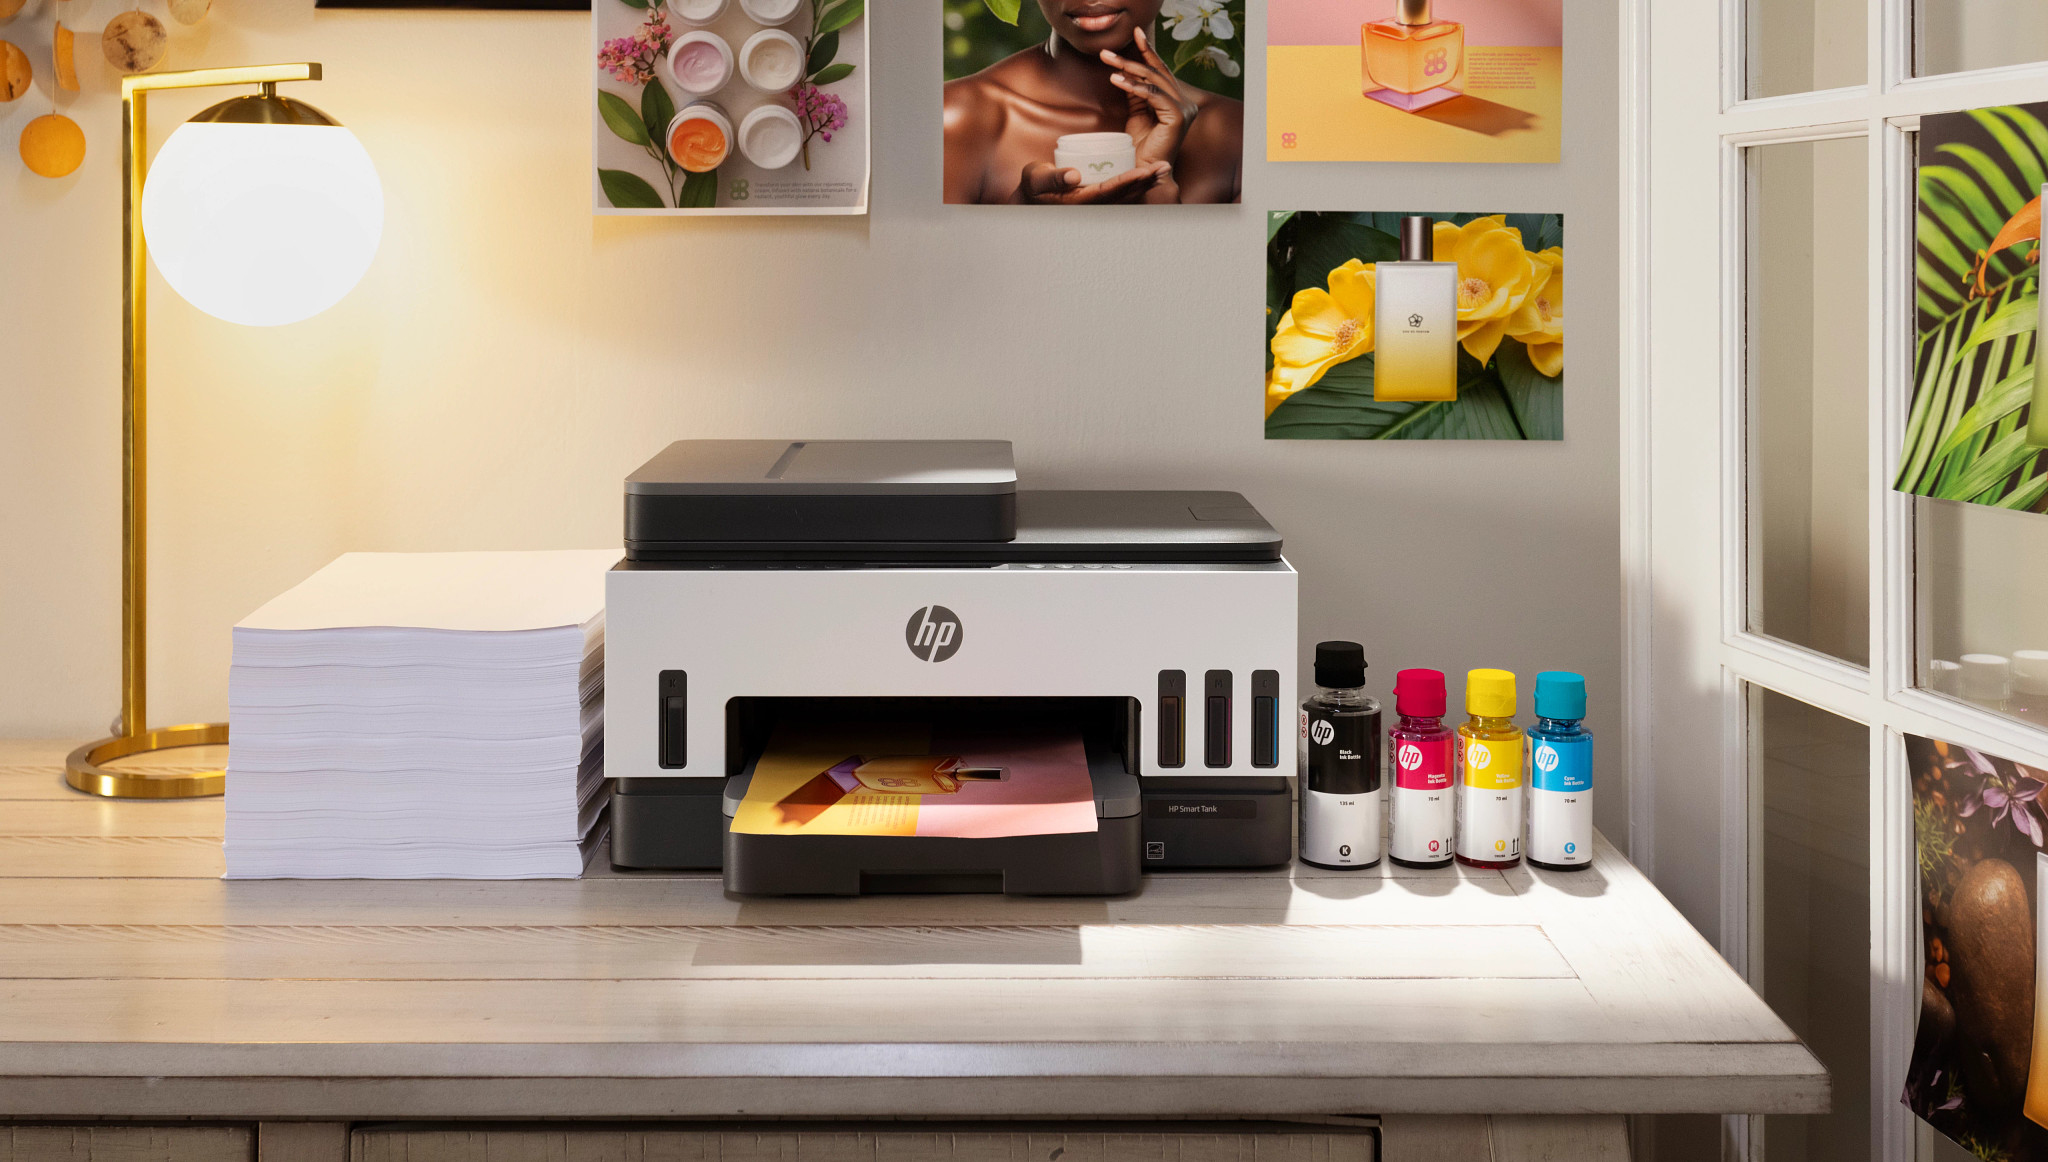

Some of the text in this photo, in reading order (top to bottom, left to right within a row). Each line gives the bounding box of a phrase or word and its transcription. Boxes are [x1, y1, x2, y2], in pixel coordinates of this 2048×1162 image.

[911, 604, 958, 662] hp
[1313, 719, 1333, 746] hp
[1400, 744, 1421, 770] hp
[1469, 744, 1490, 770] hp
[1536, 746, 1557, 772] hp
